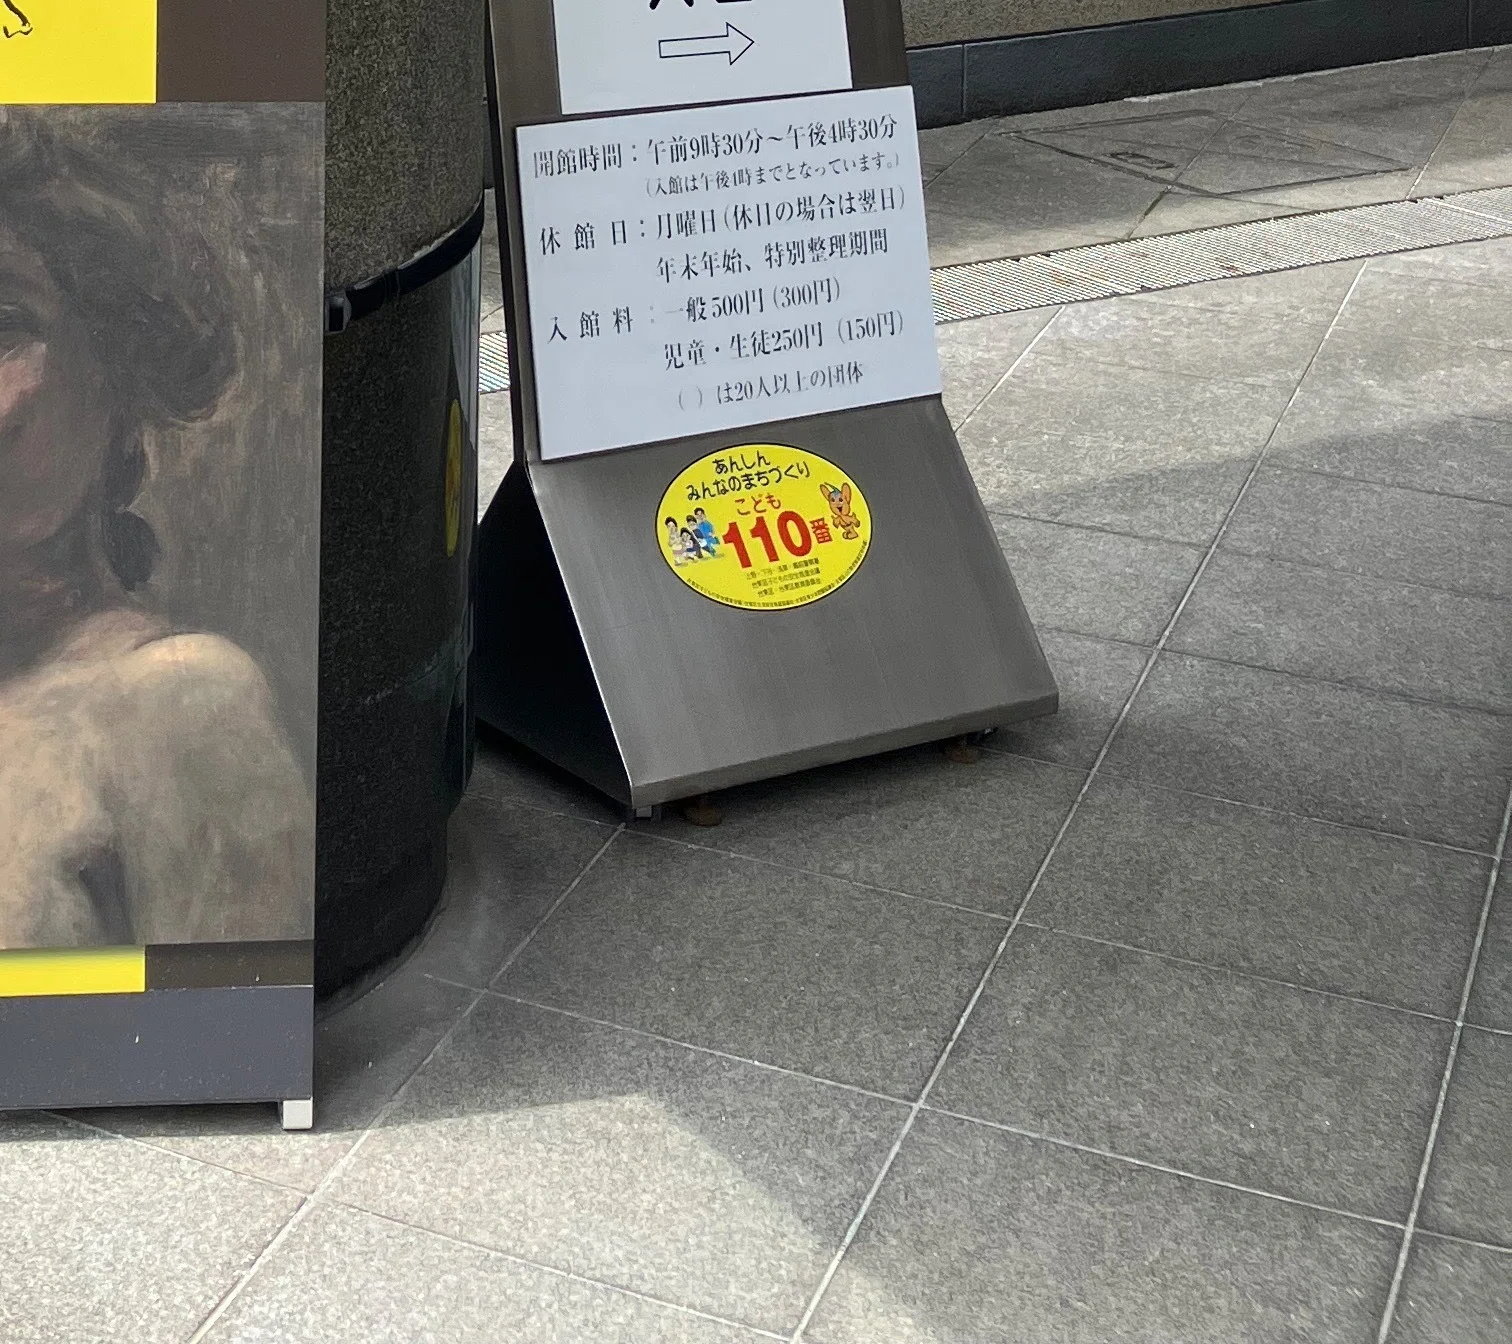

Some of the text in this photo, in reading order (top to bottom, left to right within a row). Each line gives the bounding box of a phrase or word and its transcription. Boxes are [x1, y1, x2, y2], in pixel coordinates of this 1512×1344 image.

[712, 449, 771, 475] あんしん
[685, 461, 810, 501] みんなのまちづくり
[734, 493, 782, 516] こども
